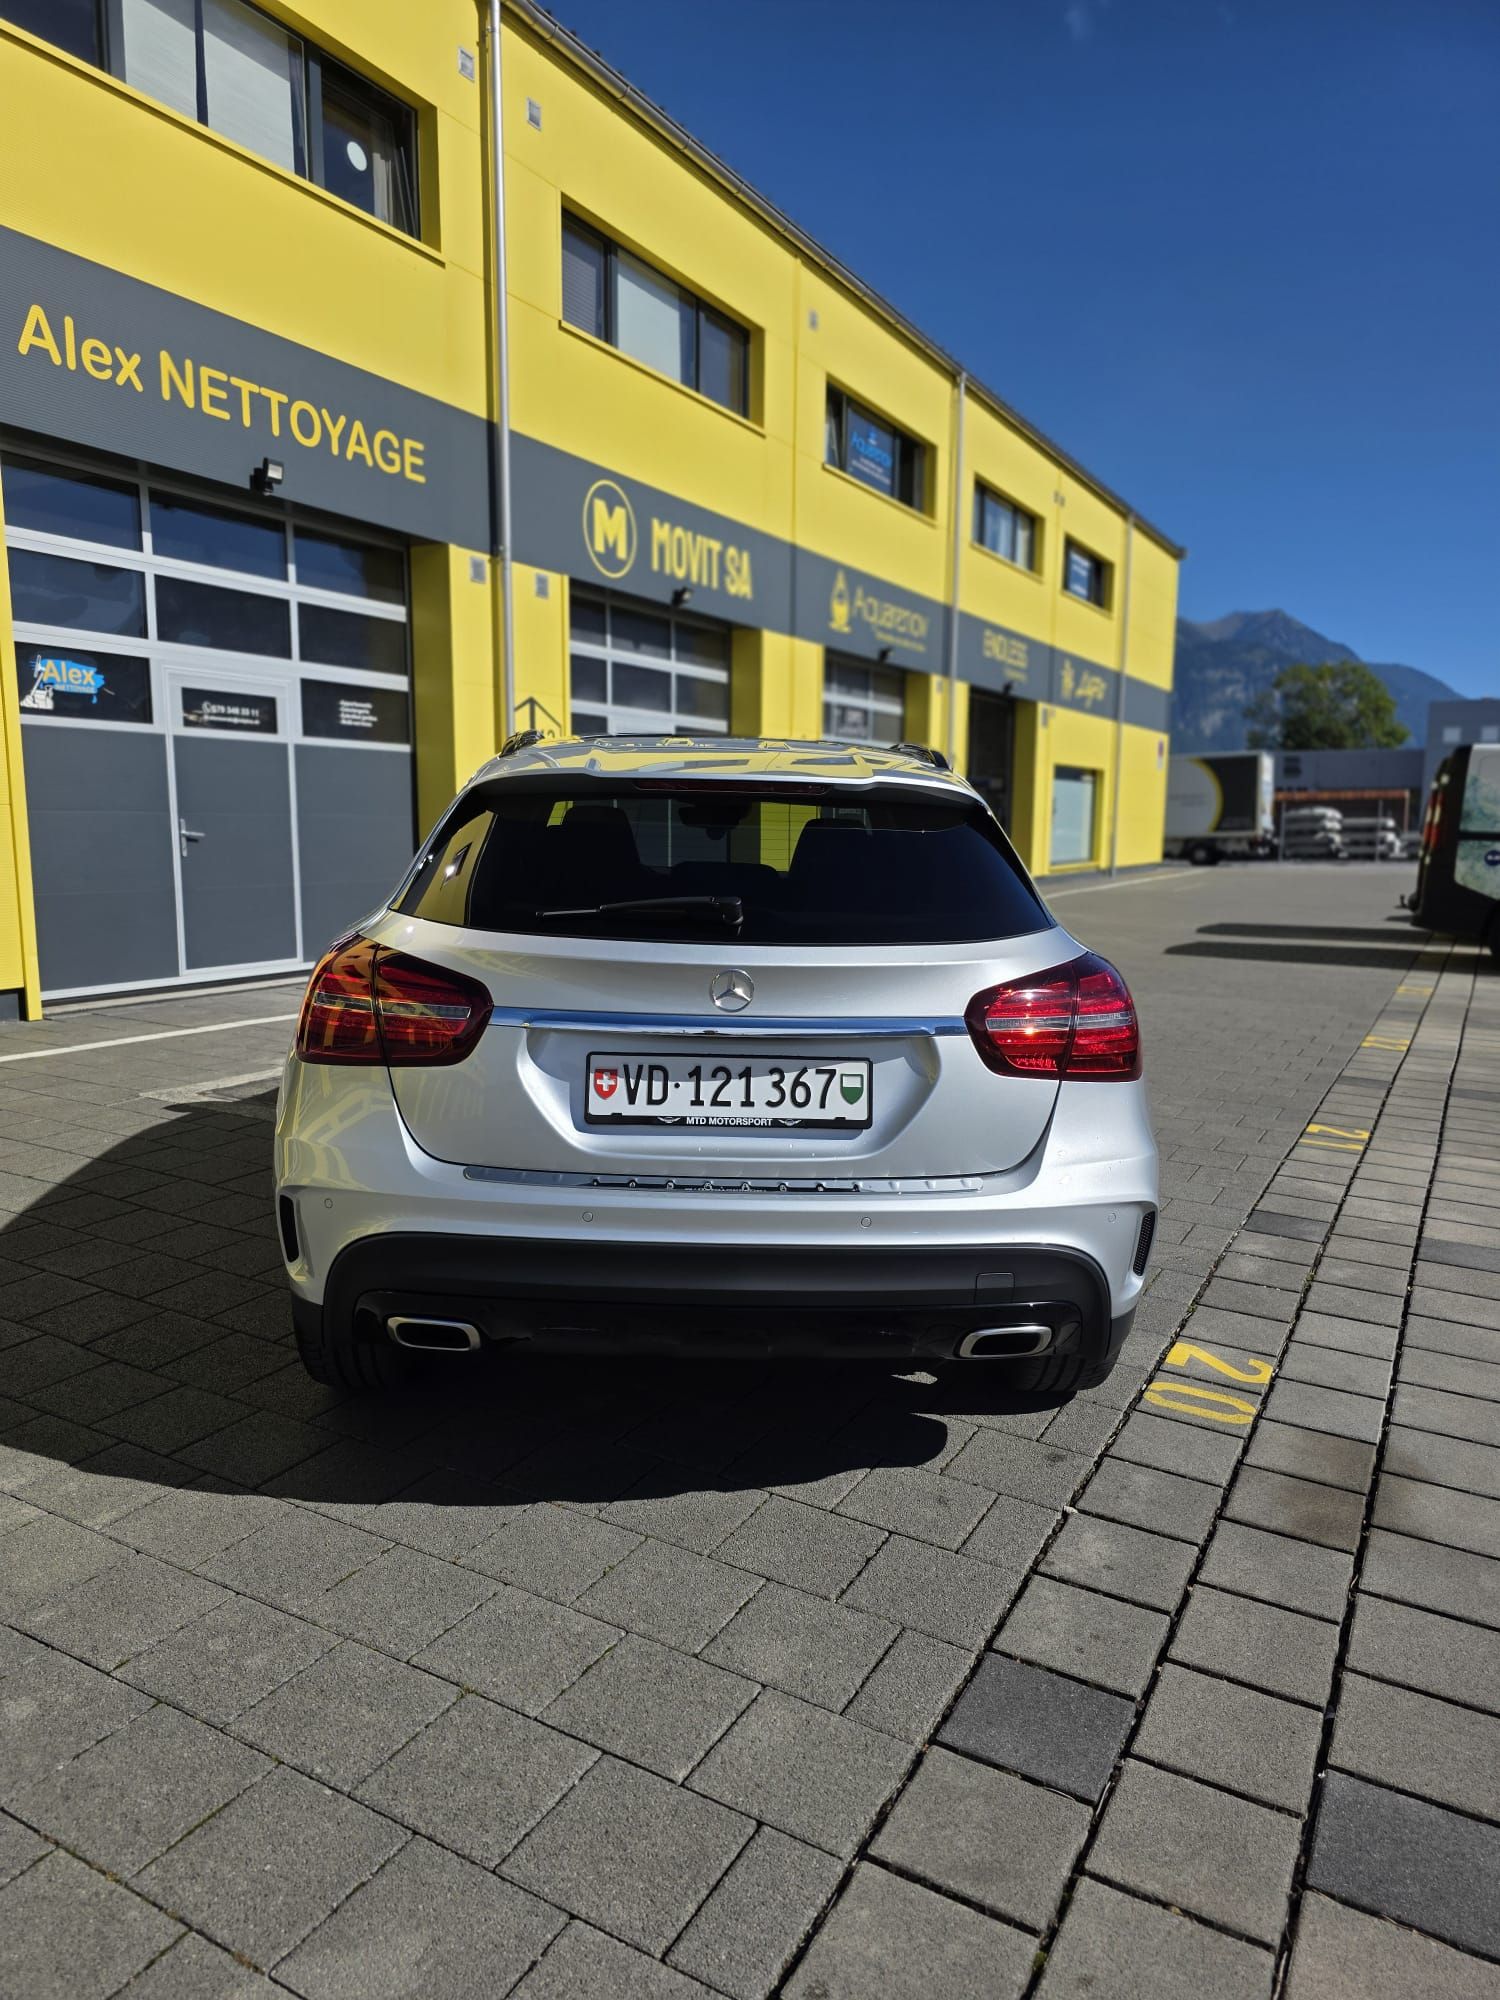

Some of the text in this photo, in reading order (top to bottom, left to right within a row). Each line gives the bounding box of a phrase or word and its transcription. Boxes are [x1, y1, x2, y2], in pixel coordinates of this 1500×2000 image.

[18, 304, 427, 483] Alex NETTOYAGE
[651, 517, 753, 599] MOVIT SA
[43, 660, 96, 686] Alex
[686, 1116, 773, 1127] MTD MOTORSPORT
[1143, 1342, 1274, 1425] 20
